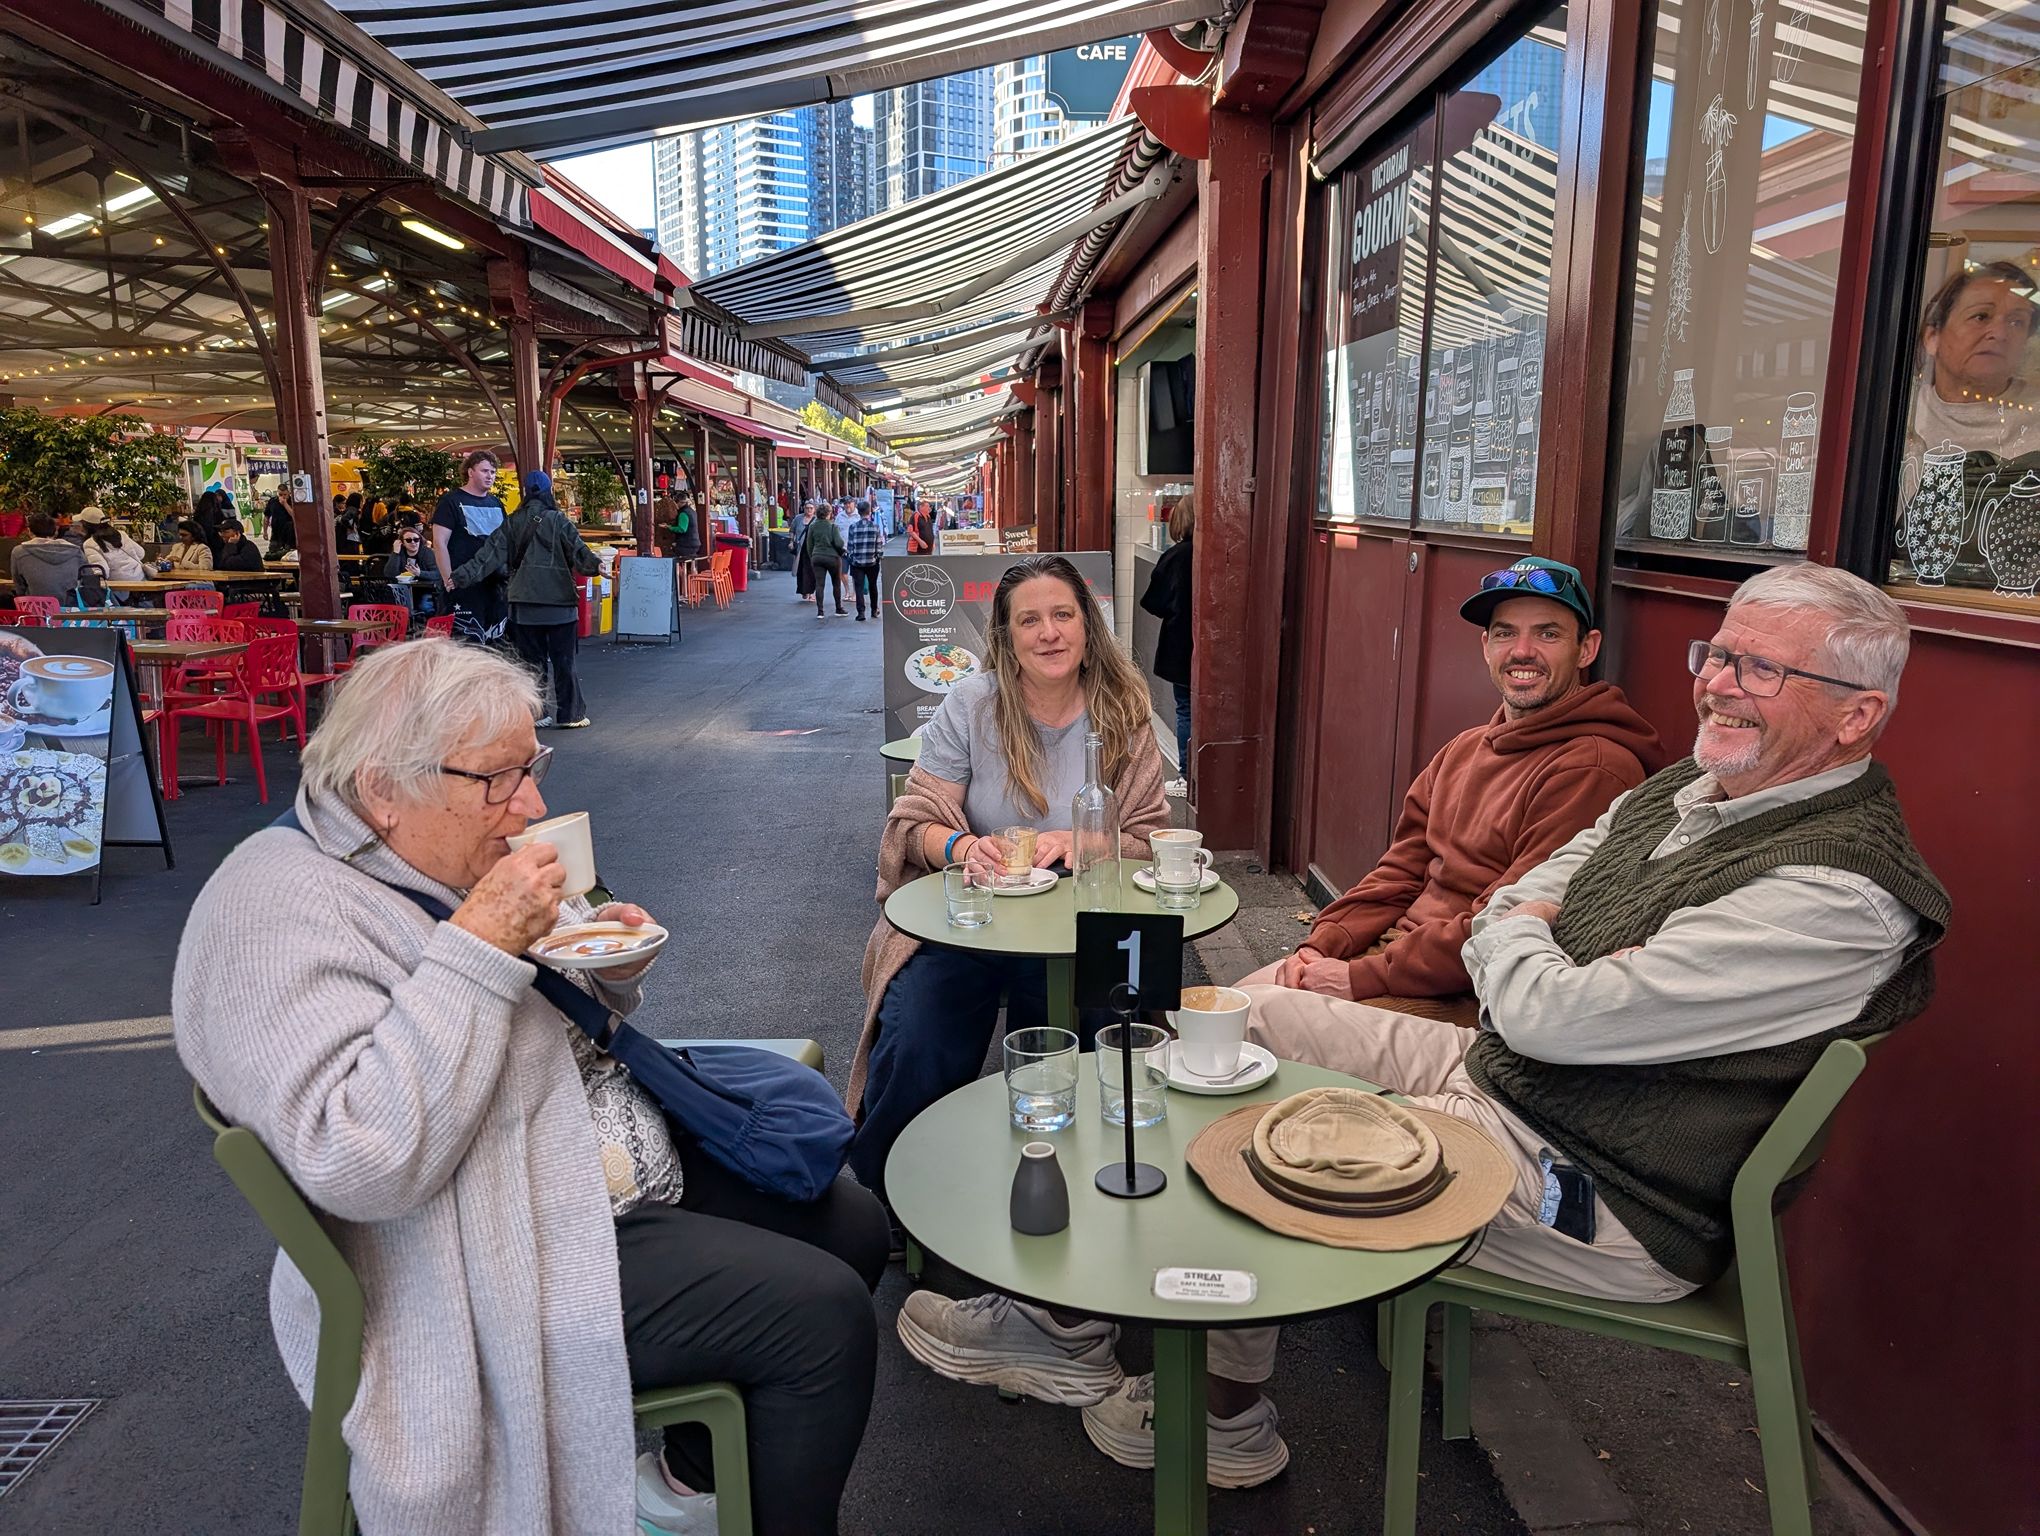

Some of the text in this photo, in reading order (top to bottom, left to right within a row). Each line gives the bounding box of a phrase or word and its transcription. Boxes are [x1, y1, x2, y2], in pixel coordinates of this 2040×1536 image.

[1076, 45, 1127, 60] CAFE
[1371, 144, 1409, 194] VICTORIAN
[1522, 375, 1537, 392] HOPE
[1674, 426, 1679, 438] A
[1665, 437, 1687, 452] PANTRY
[1789, 441, 1805, 456] HOT
[1785, 456, 1805, 472] CHOC
[1512, 466, 1530, 481] ZERO
[1513, 481, 1530, 497] WASTE
[1704, 489, 1723, 499] BEES
[1741, 484, 1755, 498] TRY
[1473, 491, 1504, 504] ARTISINAL
[1739, 503, 1756, 514] CHAI
[1005, 530, 1029, 540] Sweet
[1007, 538, 1038, 549] Croffles
[902, 598, 946, 608] GÖZLEME
[930, 607, 947, 615] cafe
[1117, 930, 1141, 995] 1
[1184, 1272, 1223, 1281] STREAT
